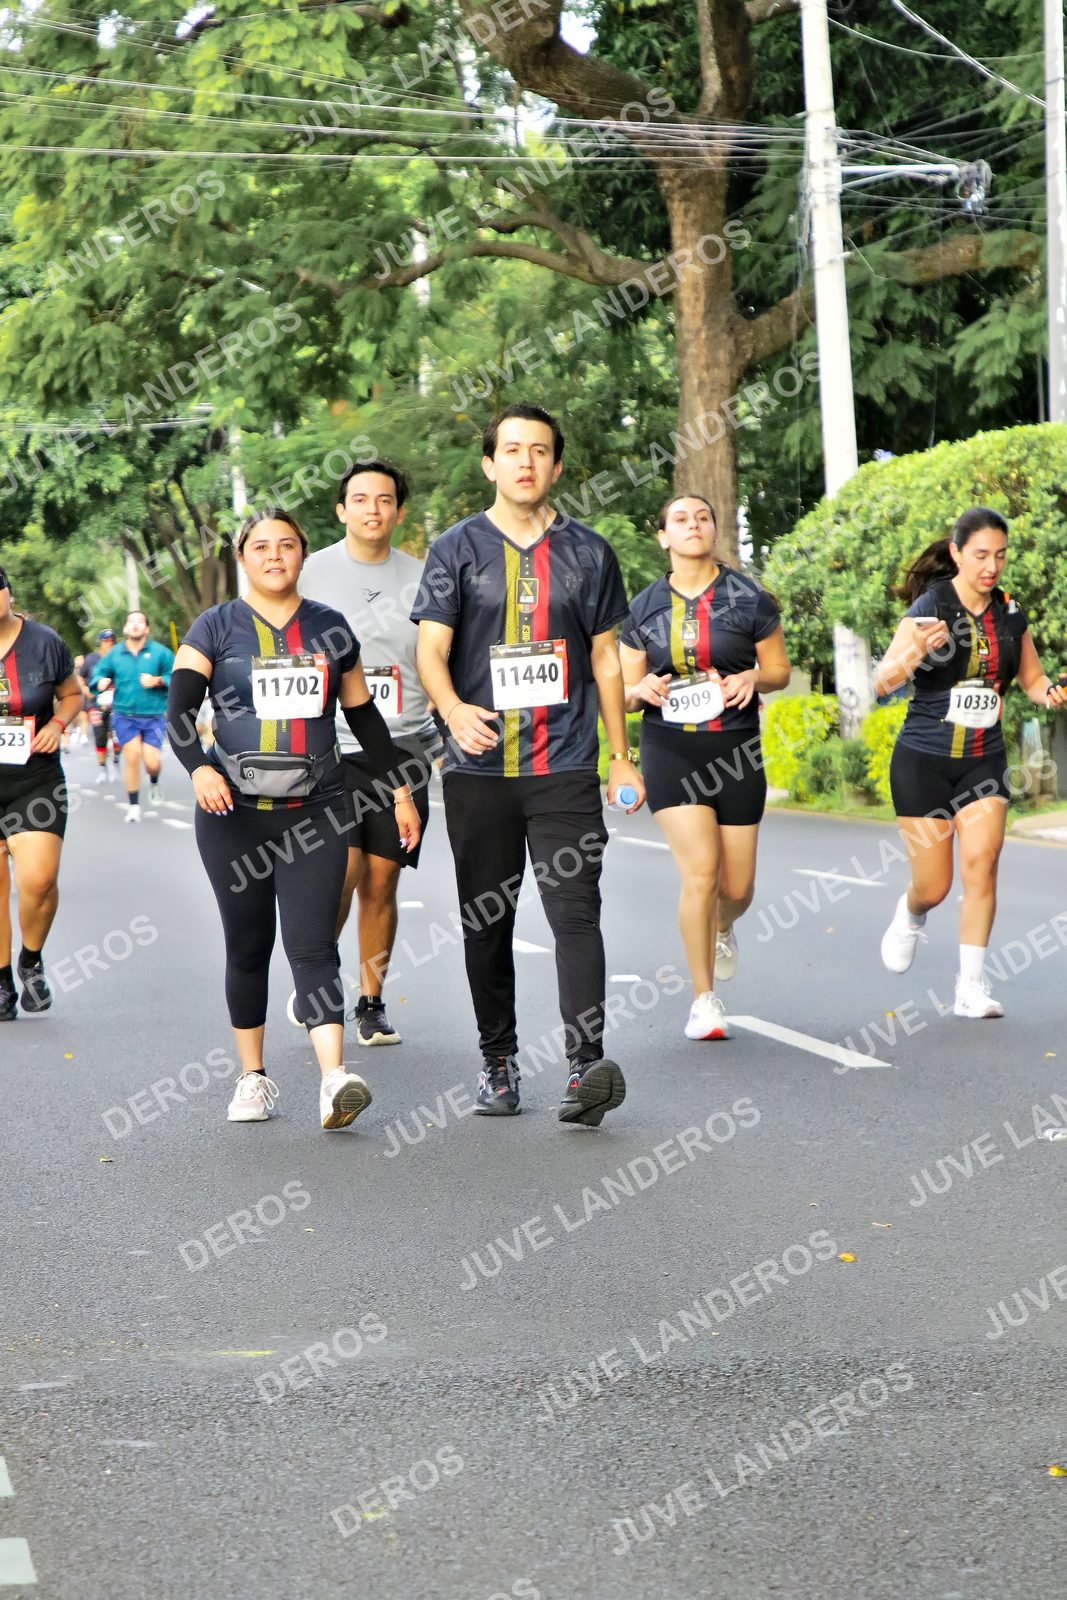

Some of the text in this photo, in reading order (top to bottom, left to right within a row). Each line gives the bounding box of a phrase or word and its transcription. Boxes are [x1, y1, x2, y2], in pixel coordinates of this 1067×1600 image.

[257, 675, 320, 697] 11702
[497, 662, 559, 687] 11440
[669, 689, 712, 713] 9909
[956, 695, 998, 710] 10339
